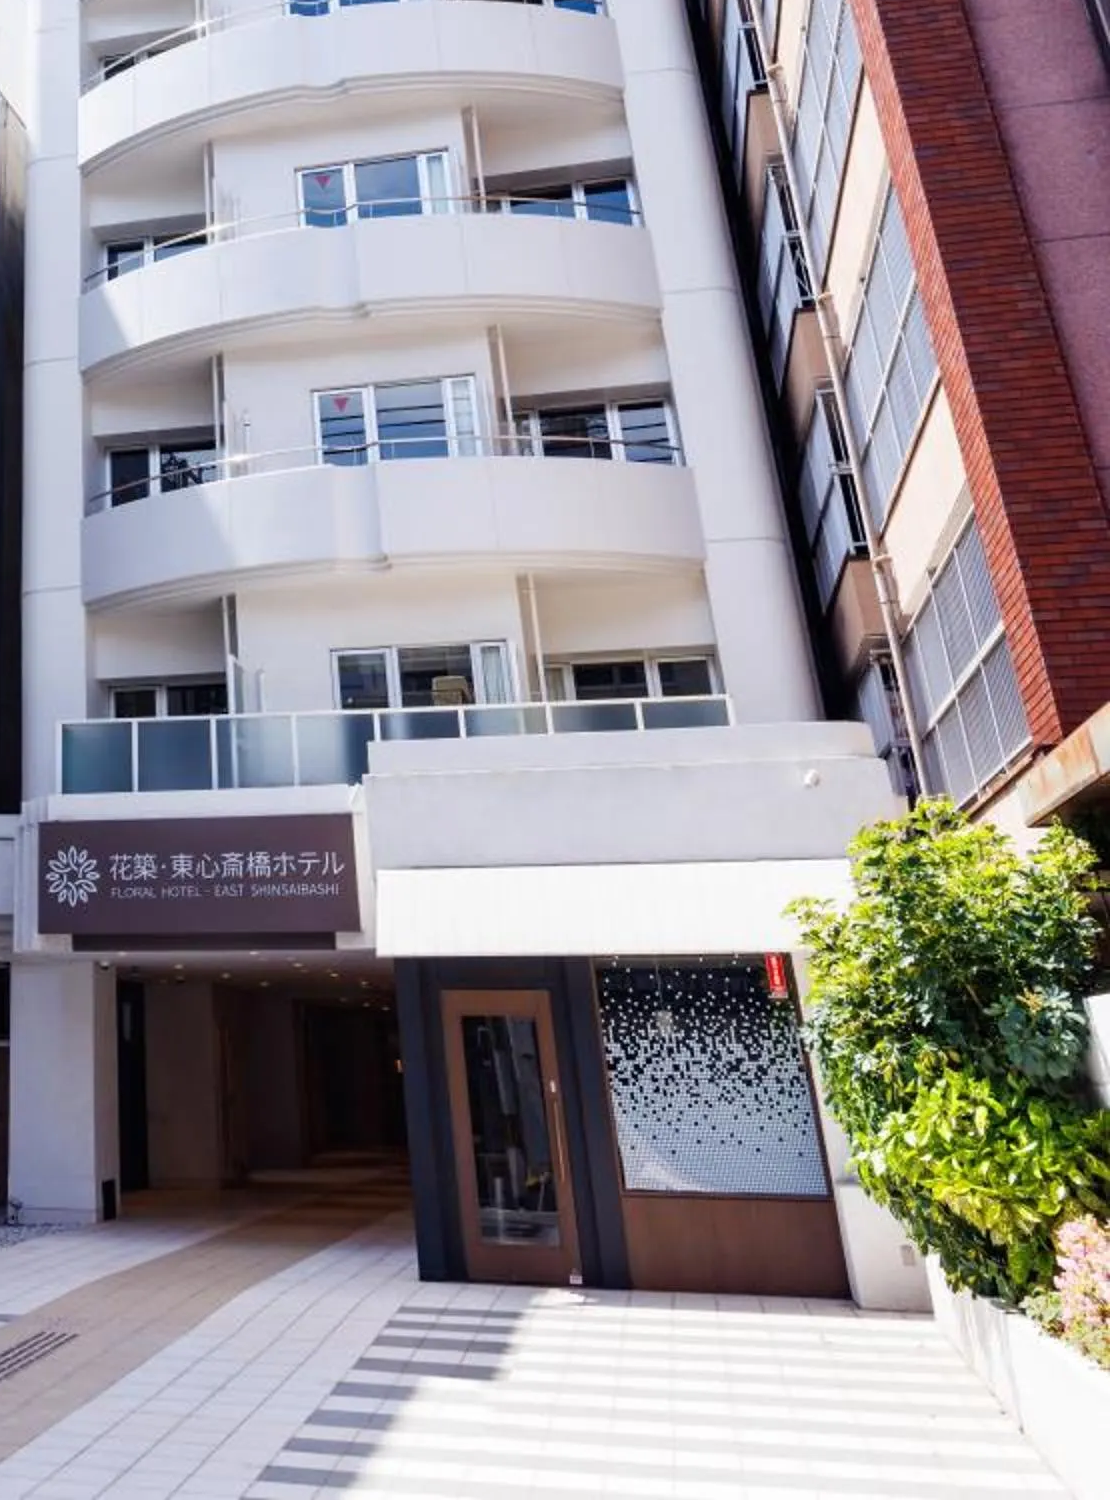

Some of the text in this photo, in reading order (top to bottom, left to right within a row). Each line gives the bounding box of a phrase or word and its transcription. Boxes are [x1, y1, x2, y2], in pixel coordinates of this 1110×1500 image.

[110, 886, 157, 899] FLORAL
[160, 885, 202, 898] HOTEL
[213, 883, 244, 897] EAST
[251, 883, 340, 897] SHINSAIBASHI
